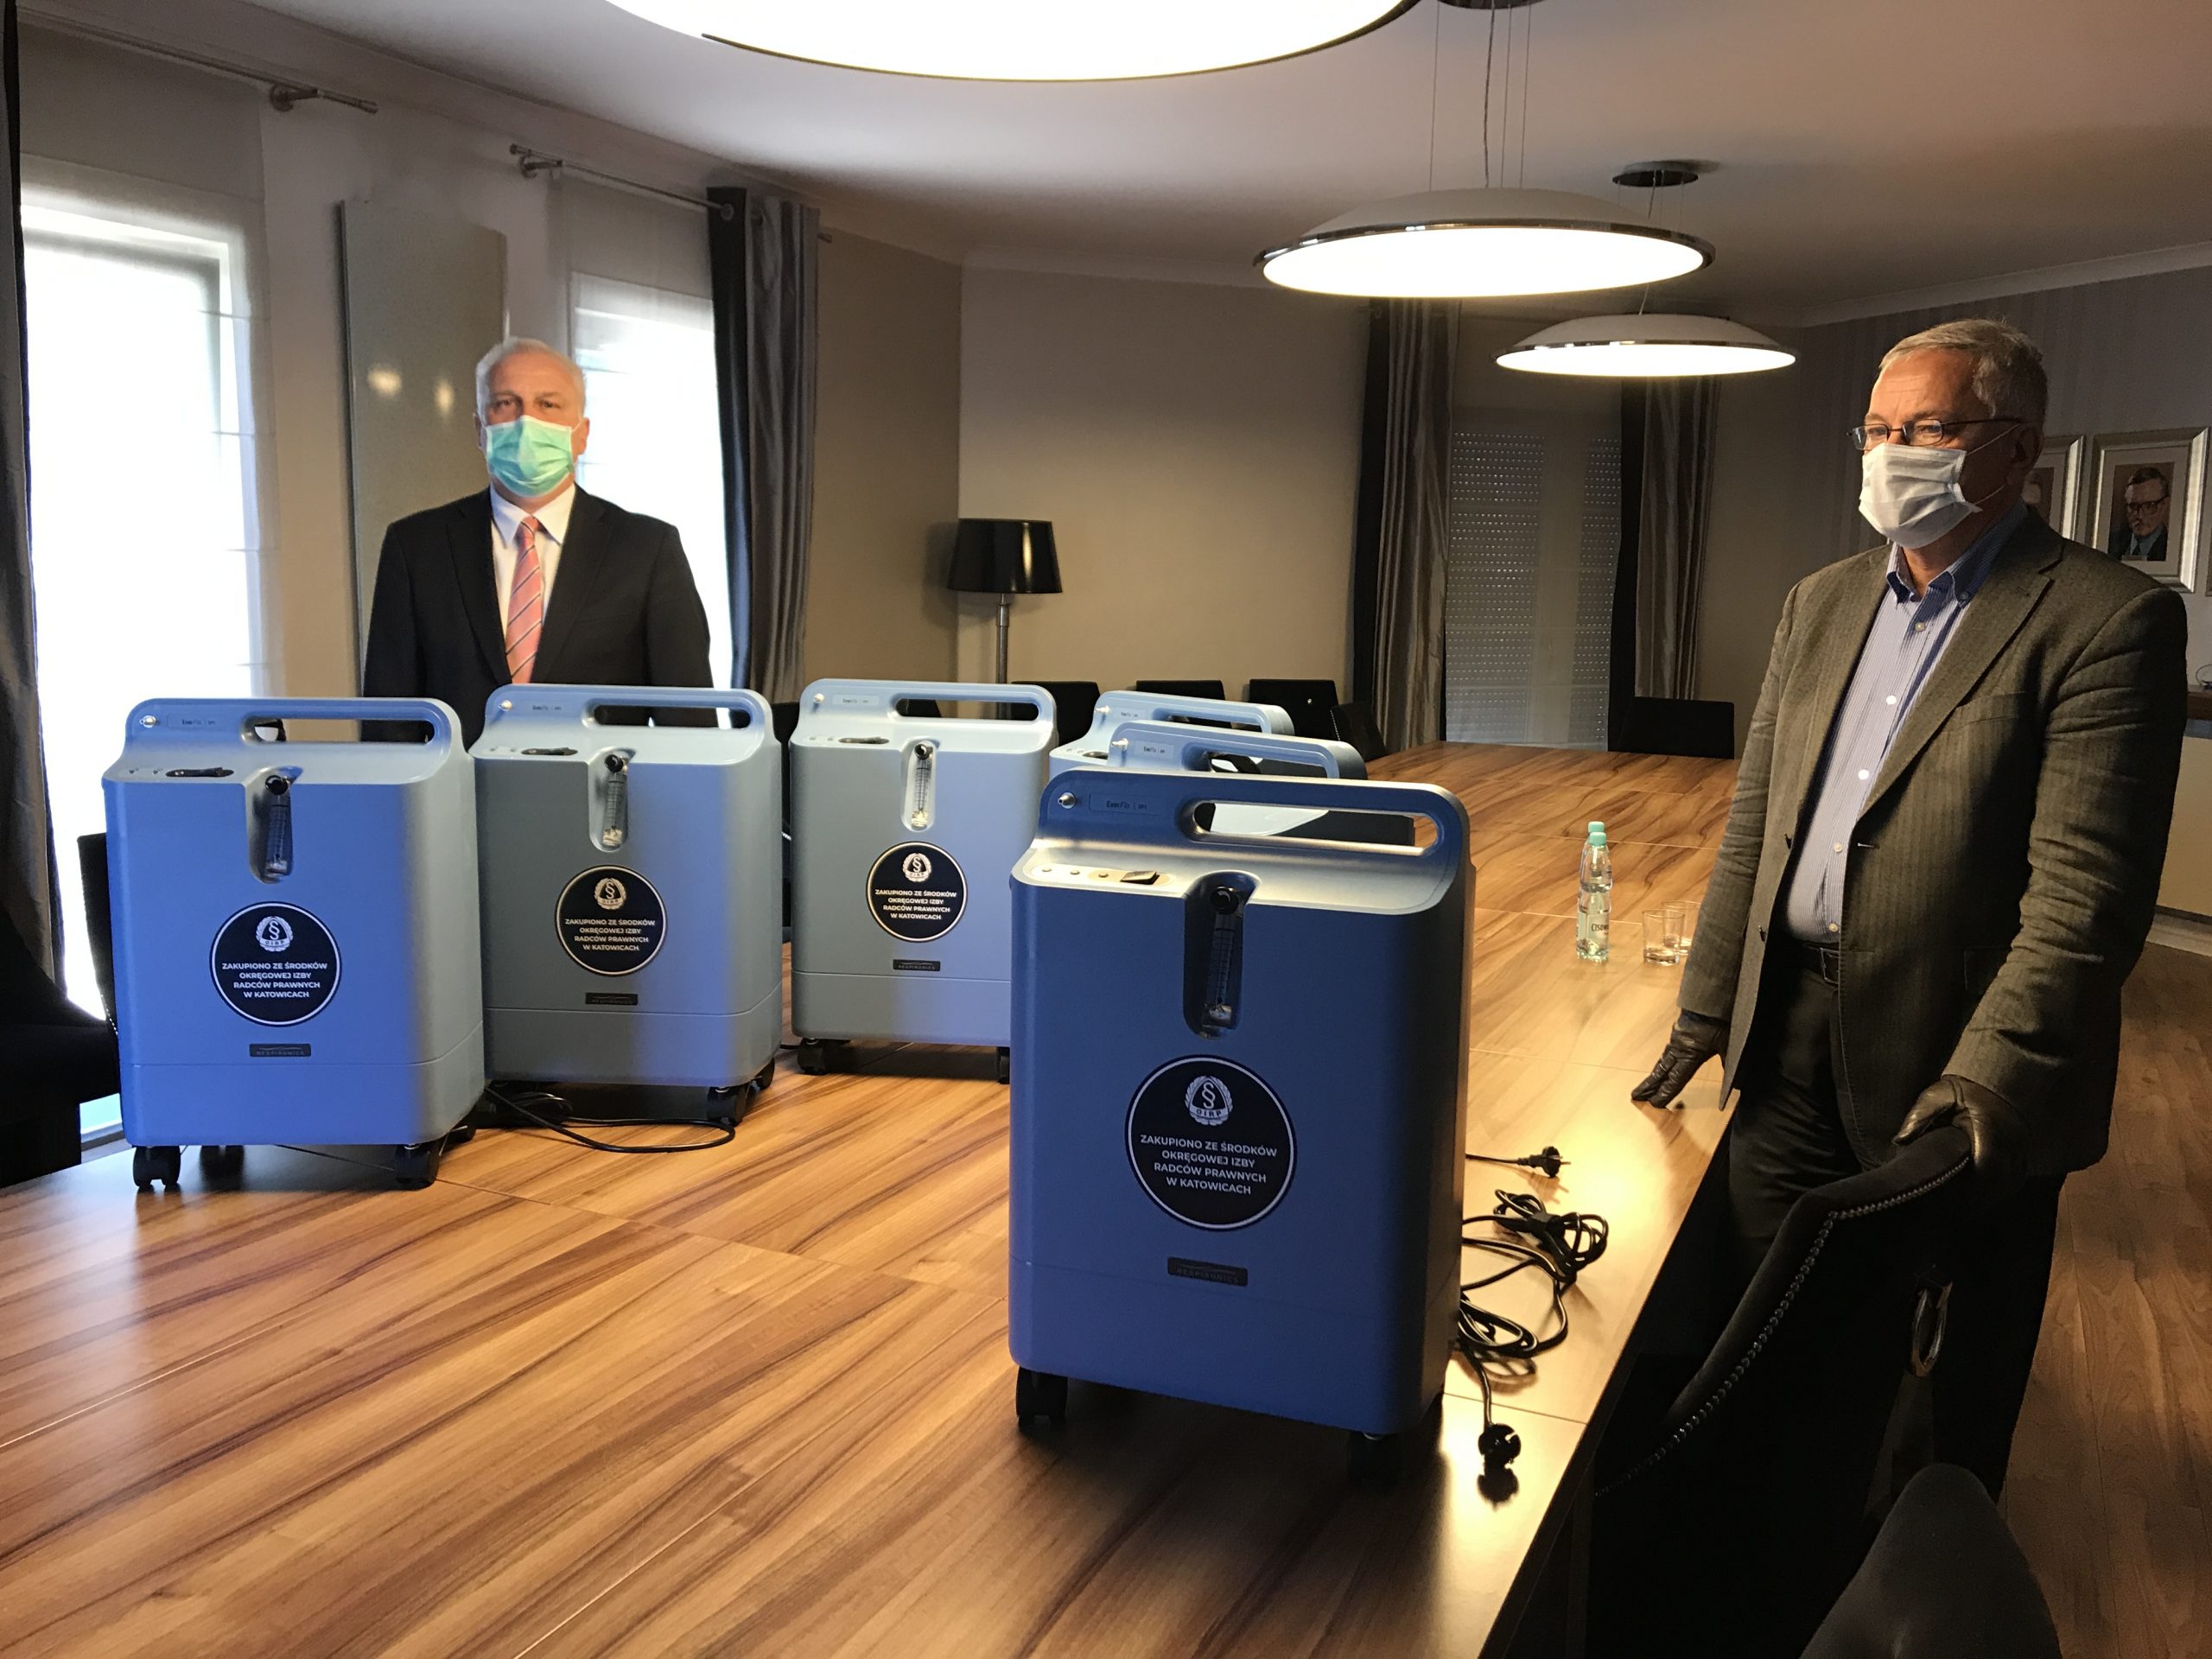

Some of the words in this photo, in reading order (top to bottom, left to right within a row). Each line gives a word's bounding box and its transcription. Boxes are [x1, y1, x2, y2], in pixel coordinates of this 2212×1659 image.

[239, 972, 291, 981] OKRĘGOWEJ
[1140, 1134, 1203, 1149] ZAKUPIONO
[1205, 1141, 1217, 1151] ZE
[1220, 1141, 1278, 1157] ŚRODKÓW
[1161, 1149, 1228, 1165] OKRĘGOWEJ
[1231, 1157, 1255, 1168] IZBY
[1154, 1162, 1202, 1176] RADCÓW
[1205, 1167, 1267, 1183] PRAWNYCH
[1166, 1176, 1178, 1186] W
[1180, 1178, 1251, 1195] KATOWICACH
